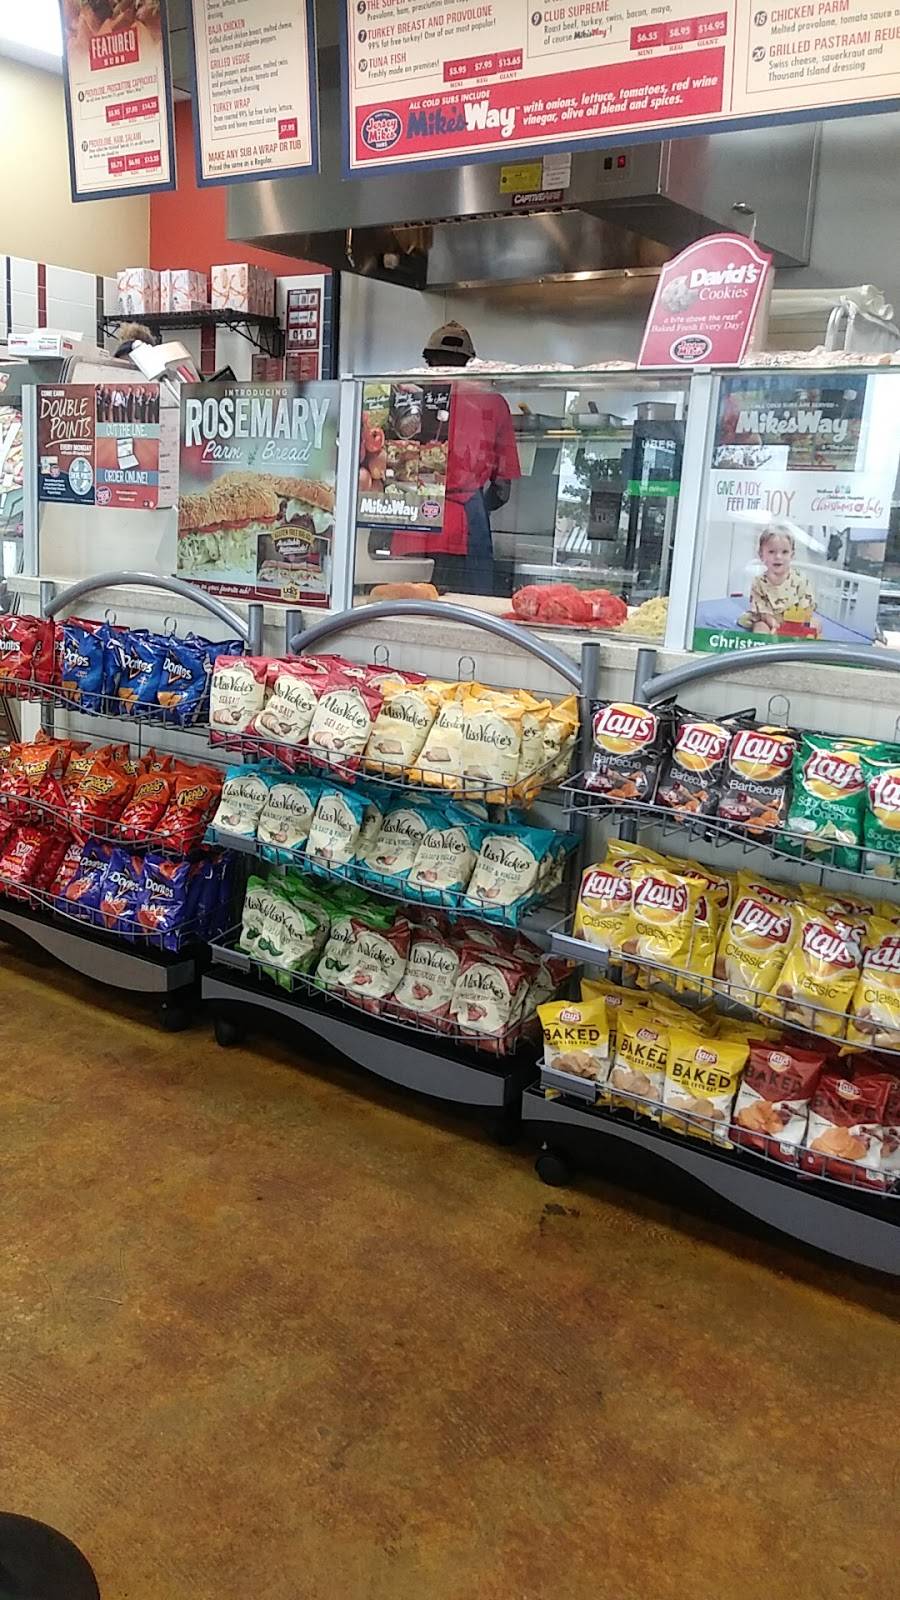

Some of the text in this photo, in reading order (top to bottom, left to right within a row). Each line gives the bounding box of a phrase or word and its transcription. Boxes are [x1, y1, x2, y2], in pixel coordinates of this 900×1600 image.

[368, 5, 493, 39] TURKEY BREAST AND PROVOLONE
[544, 1, 610, 23] CLUB SUPREME
[771, 0, 849, 23] CHICKEN PARM
[771, 22, 796, 35] Melted
[840, 14, 868, 24] tomato
[870, 11, 892, 20] sauce
[91, 30, 136, 58] FEATURED
[769, 40, 811, 58] GRILLED
[814, 31, 871, 50] PASTRAMI
[369, 53, 407, 68] TUNA FISH
[769, 60, 789, 70] Swiss
[822, 48, 865, 62] sauerkraut
[868, 44, 883, 55] and
[769, 60, 866, 82] Thousand Island dressing
[409, 89, 491, 110] ALL COLD SUBS INCLUDE
[523, 76, 719, 114] with onions, lettuce, tomatoes, red wine
[522, 94, 684, 126] vinegar, olive oil blend and spices.
[209, 150, 226, 162] MAKE
[227, 149, 239, 160] ANY
[259, 143, 279, 156] WRAP
[290, 139, 302, 150] TUB
[690, 263, 760, 289] David's
[699, 286, 749, 301] Cookies
[224, 388, 288, 398] INTRODUCING
[40, 398, 89, 419] DOUBLE
[50, 416, 92, 440] POINTS
[184, 397, 331, 450] ROSEMARY
[201, 439, 313, 461] Parm Bread
[716, 480, 735, 495] GIVE
[122, 652, 154, 674] Doritos
[163, 657, 192, 680] Doritos
[401, 704, 428, 729] Vickie's
[479, 722, 512, 749] Vickie's
[592, 752, 641, 770] Barbecue
[670, 767, 709, 787] Barbecue
[729, 779, 784, 796] Barbecue
[176, 785, 209, 805] Cheetos
[396, 819, 425, 841] Vickie's
[80, 857, 108, 872] Doritos
[498, 849, 531, 873] Vickie's
[109, 870, 139, 893] Doritos
[145, 879, 174, 898] Doritos
[582, 914, 623, 931] Classic
[635, 923, 674, 943] Classic
[426, 951, 456, 973] Vickie's
[724, 944, 764, 970] Classic
[543, 1028, 600, 1041] BAKED
[672, 1063, 731, 1090] BAKED
